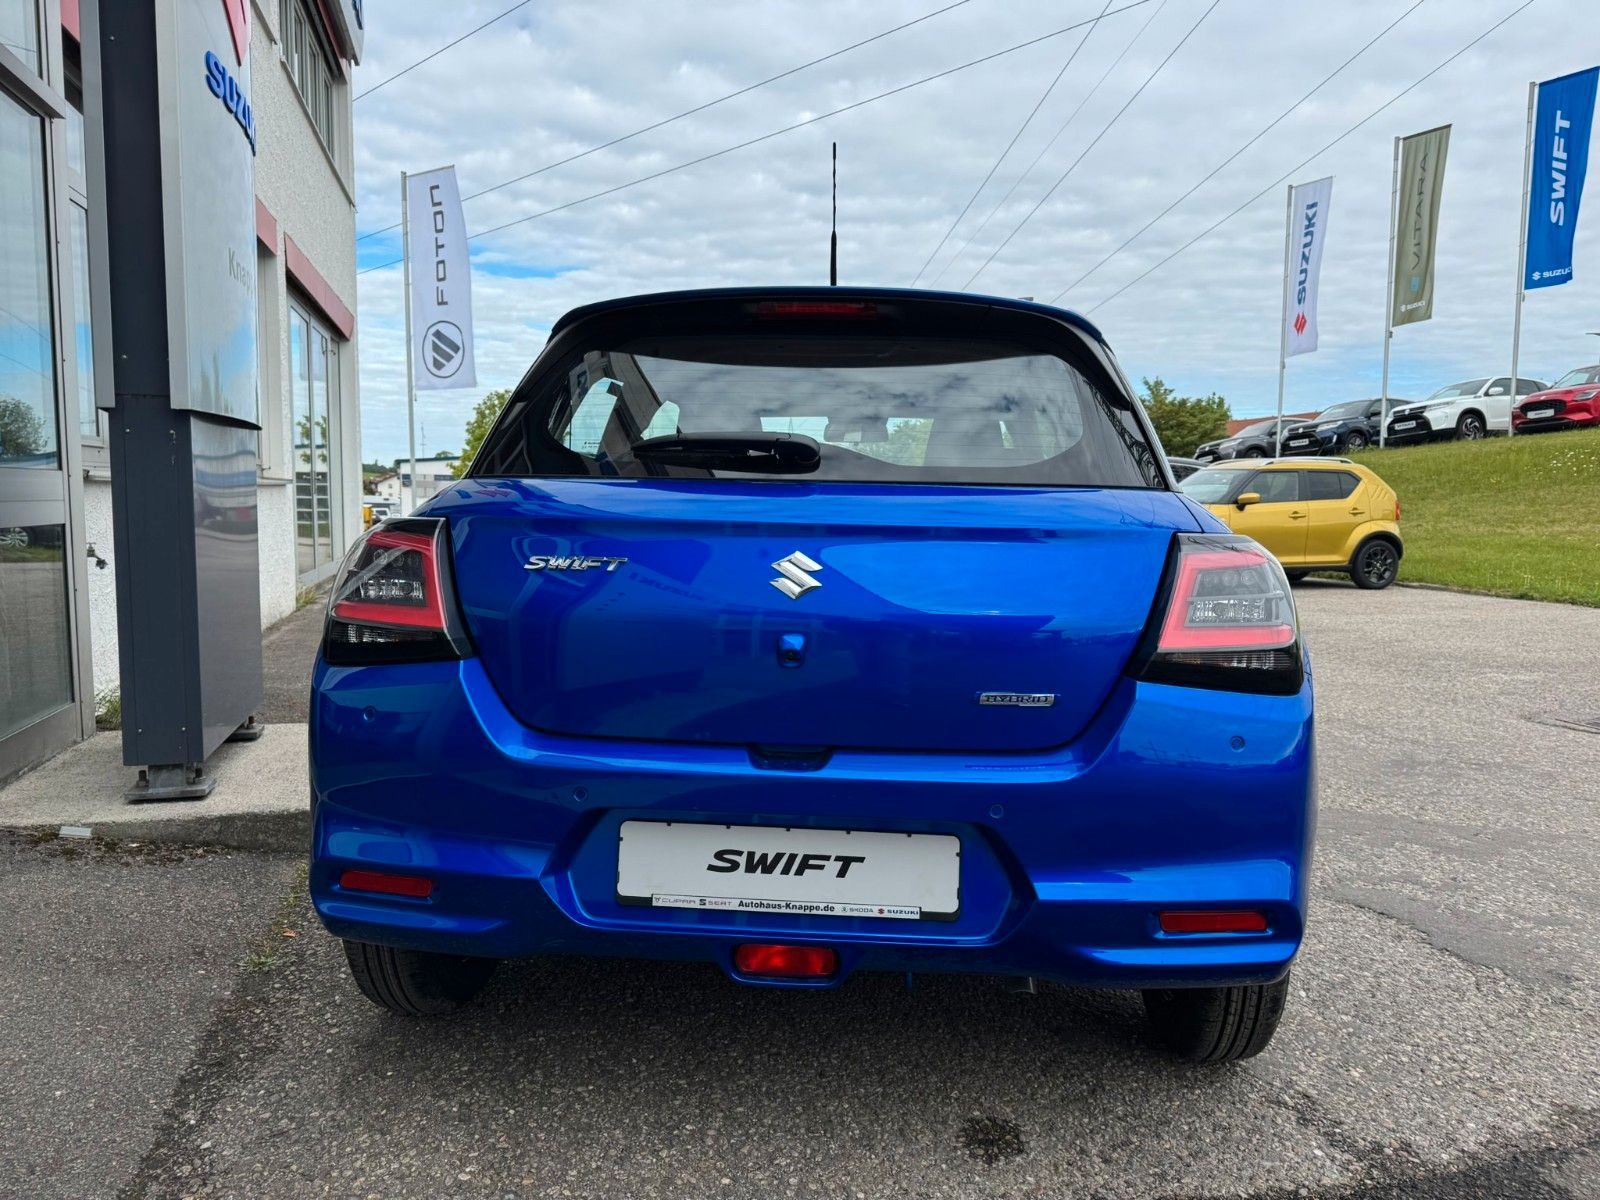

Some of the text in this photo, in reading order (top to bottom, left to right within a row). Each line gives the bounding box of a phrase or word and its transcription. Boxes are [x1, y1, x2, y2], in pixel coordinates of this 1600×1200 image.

[1550, 110, 1571, 226] SWIFT
[429, 184, 449, 306] FOTON
[1412, 153, 1429, 271] VITARA
[1297, 201, 1319, 305] SUZUKI
[523, 555, 628, 572] SWIFT
[983, 693, 1051, 705] HYBRID
[706, 849, 866, 879] SWIFT
[738, 900, 835, 912] Autohaus-Knappe.de
